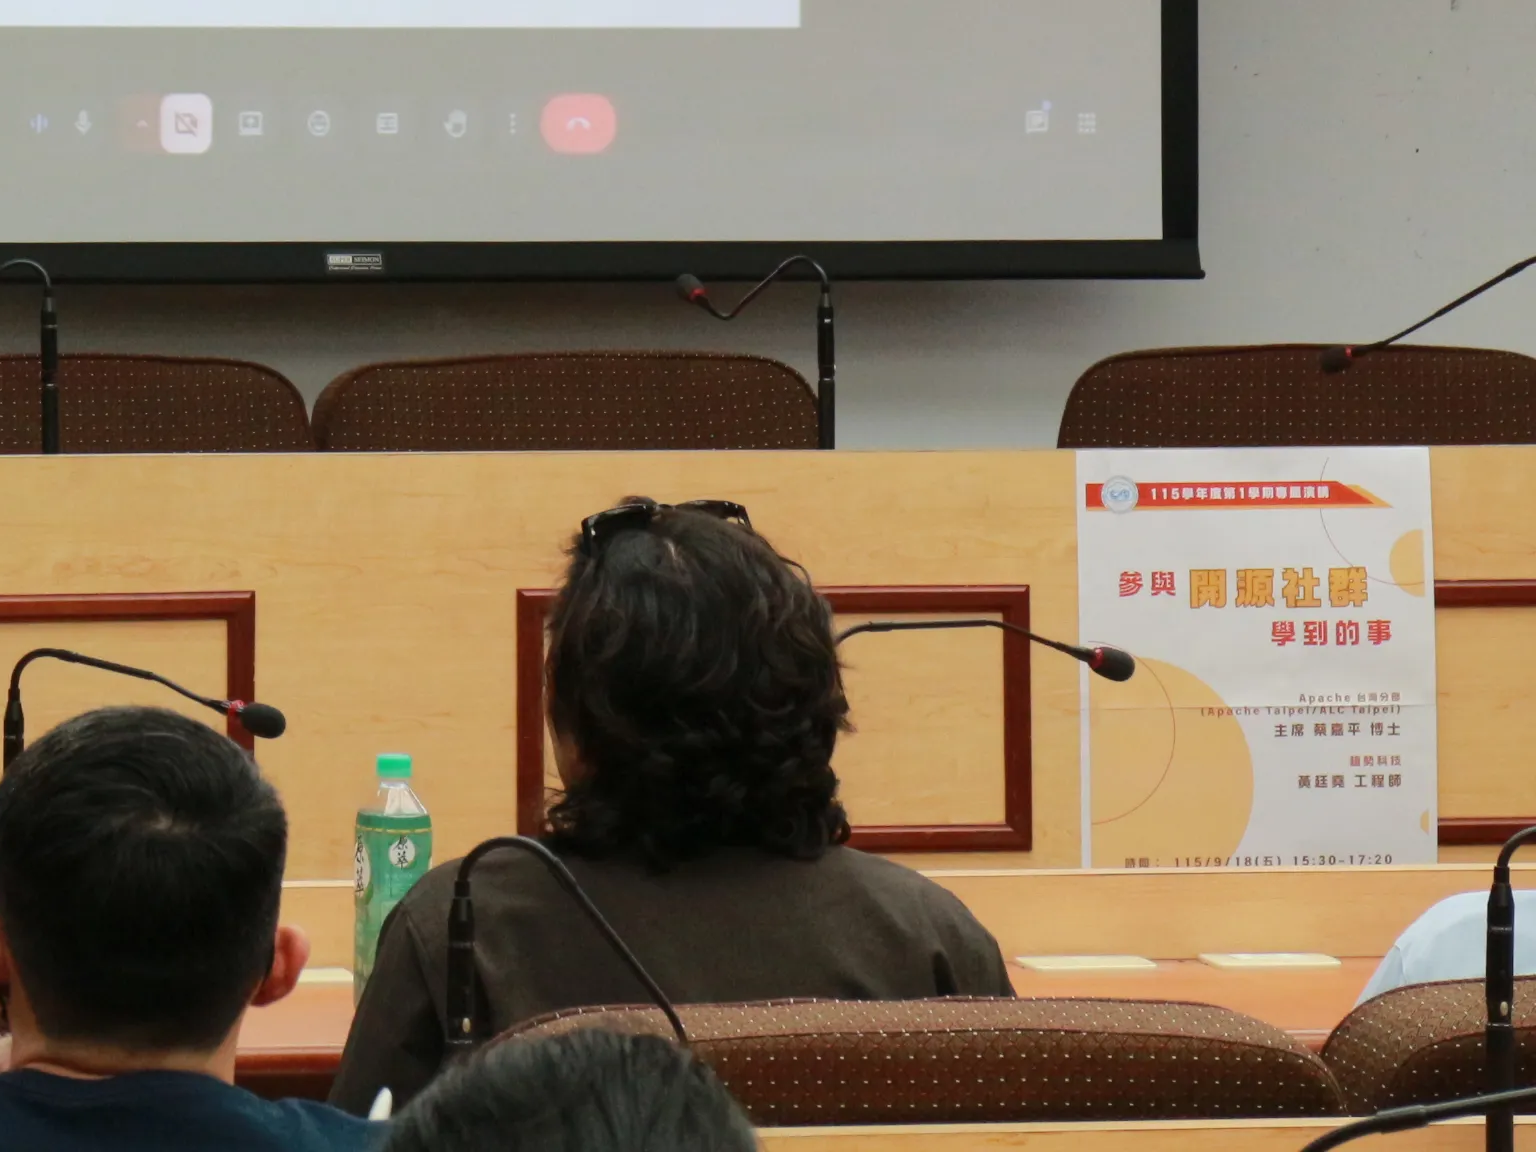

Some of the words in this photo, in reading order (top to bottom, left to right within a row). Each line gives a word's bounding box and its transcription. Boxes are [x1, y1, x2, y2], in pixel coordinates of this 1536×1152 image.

[1150, 485, 1330, 501] 115學年度第1學期專題演講
[1118, 570, 1177, 597] 參與
[1188, 566, 1369, 609] 開源社群
[1270, 619, 1393, 647] 學到的事
[1299, 693, 1351, 704] Apache
[1200, 706, 1261, 717] (Apache
[1273, 723, 1305, 738] 主席
[1313, 722, 1362, 738] 蔡嘉平
[1369, 722, 1402, 737] 博士
[1354, 773, 1403, 789] 工程師
[1173, 856, 1283, 868] 115/9/18(五)
[1292, 853, 1394, 866] 15:30-17:20
